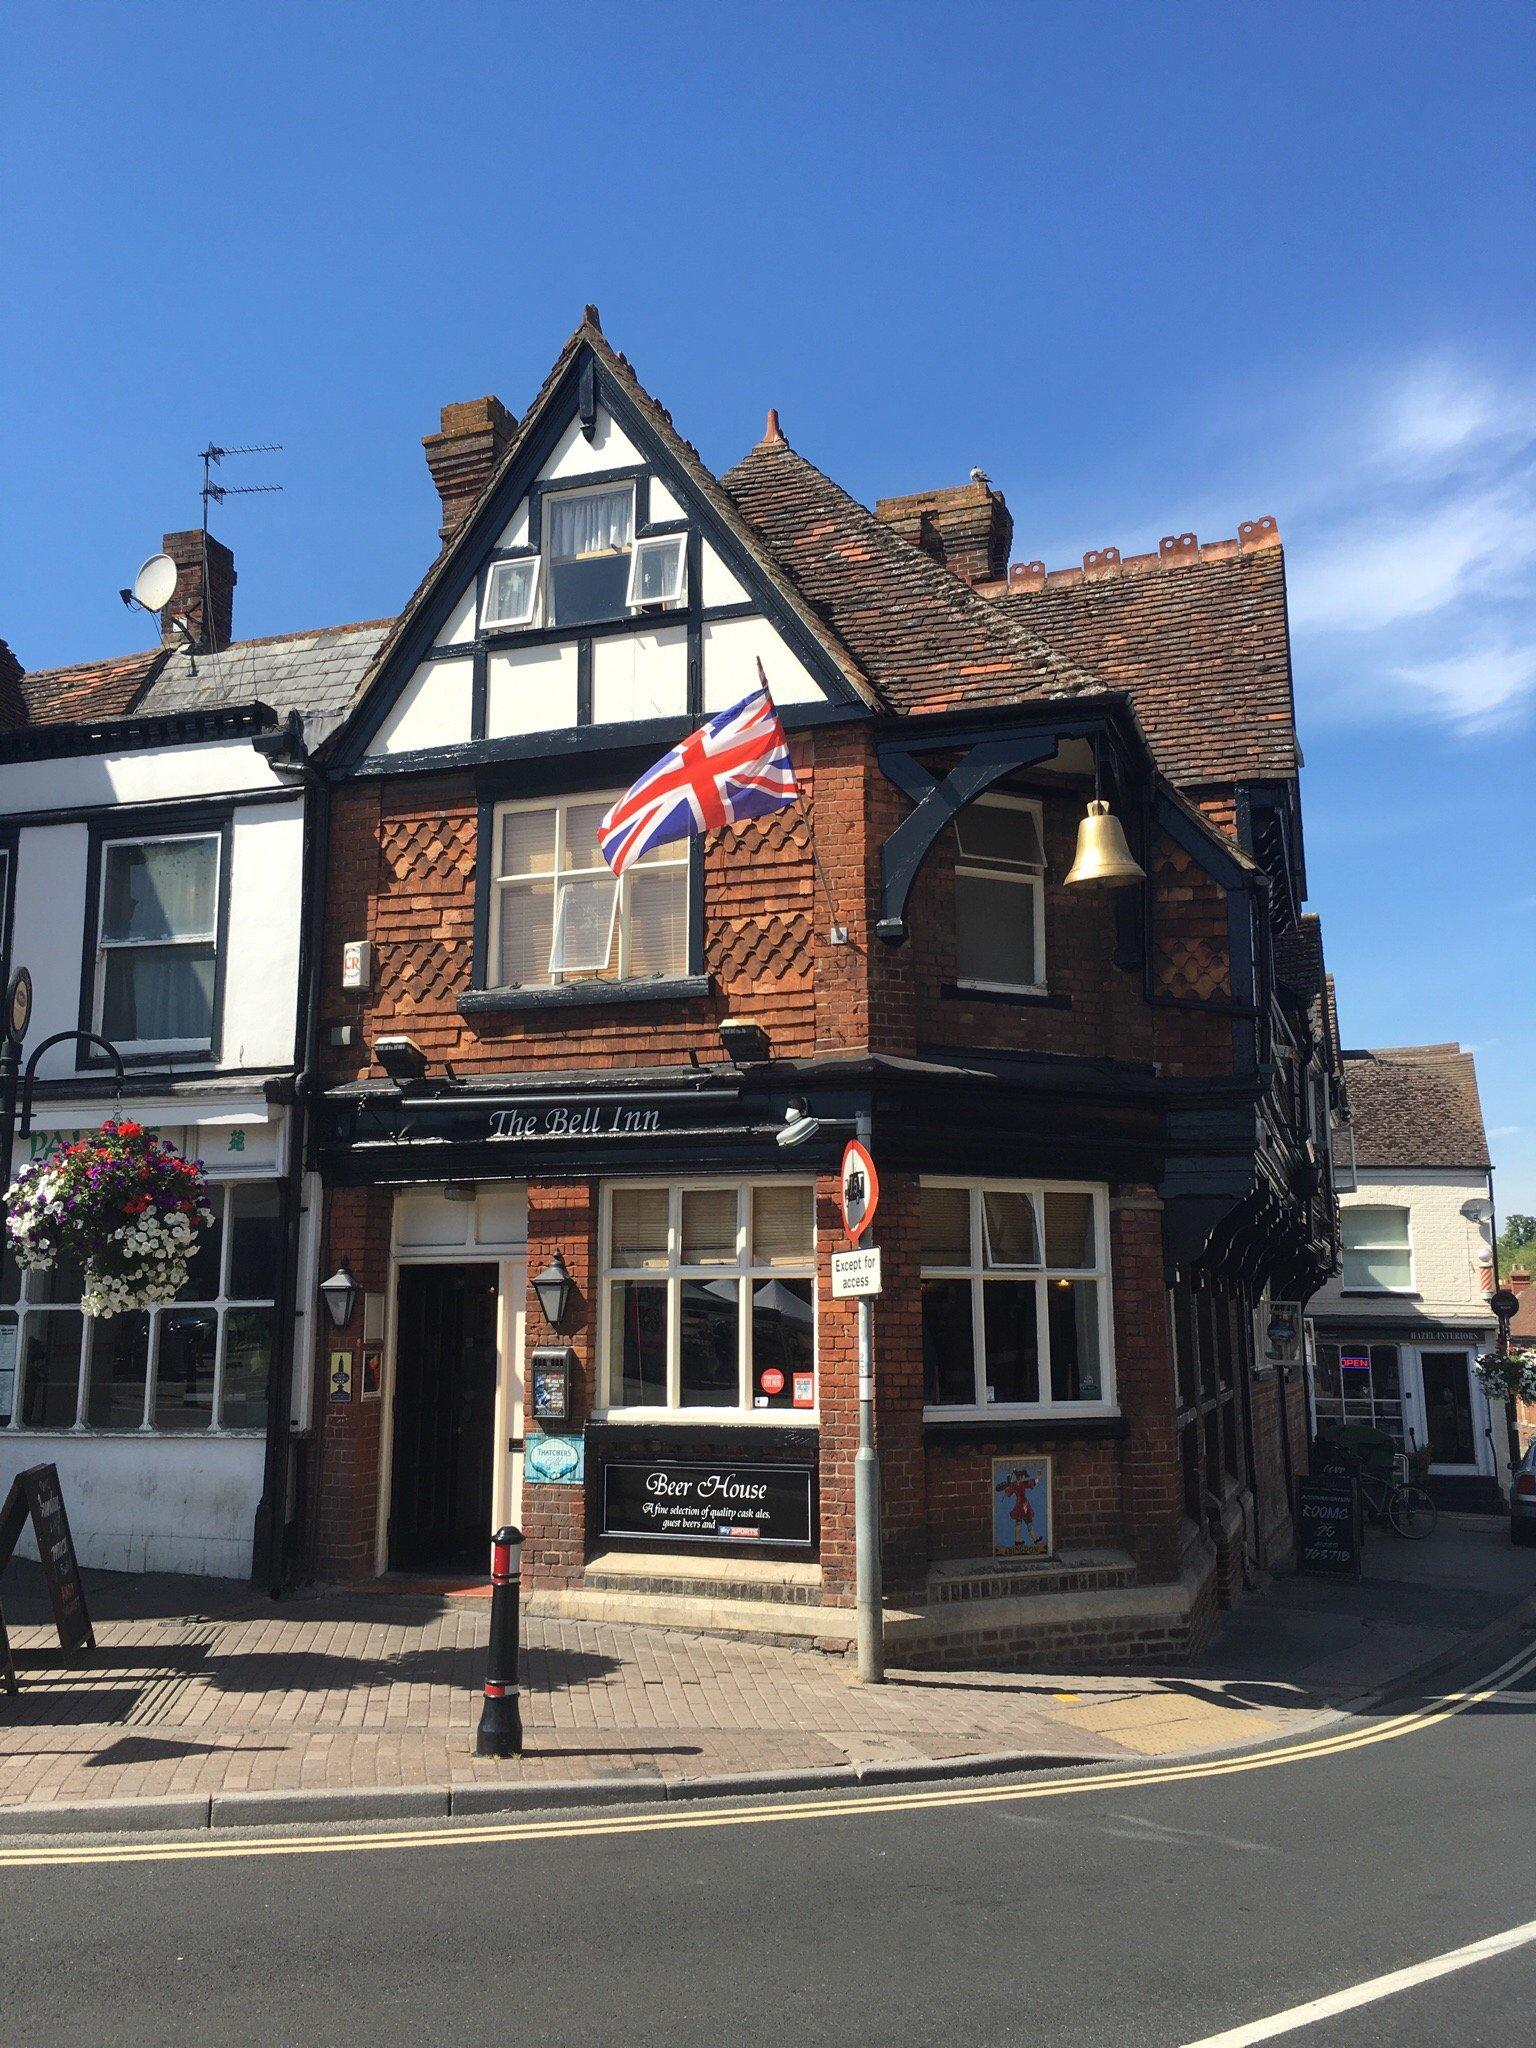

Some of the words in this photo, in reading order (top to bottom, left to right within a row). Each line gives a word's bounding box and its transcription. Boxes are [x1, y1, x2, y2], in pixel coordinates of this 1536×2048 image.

[489, 1109, 537, 1137] The
[545, 1107, 601, 1134] Bell
[608, 1106, 661, 1132] Inn
[835, 1258, 862, 1273] Except
[864, 1256, 876, 1269] for
[842, 1276, 869, 1289] access
[1437, 1331, 1480, 1340] INTERIORS
[1341, 1359, 1369, 1367] OPEN
[538, 1448, 572, 1457] THATCHERS
[646, 1472, 693, 1496] Beer
[697, 1473, 767, 1500] House
[642, 1502, 655, 1514] A
[651, 1502, 668, 1518] fine
[670, 1505, 700, 1516] selection
[700, 1504, 711, 1520] of
[709, 1507, 736, 1521] quality
[737, 1508, 753, 1518] cask
[661, 1518, 681, 1531] guest
[682, 1518, 700, 1529] beers
[702, 1519, 716, 1529] and
